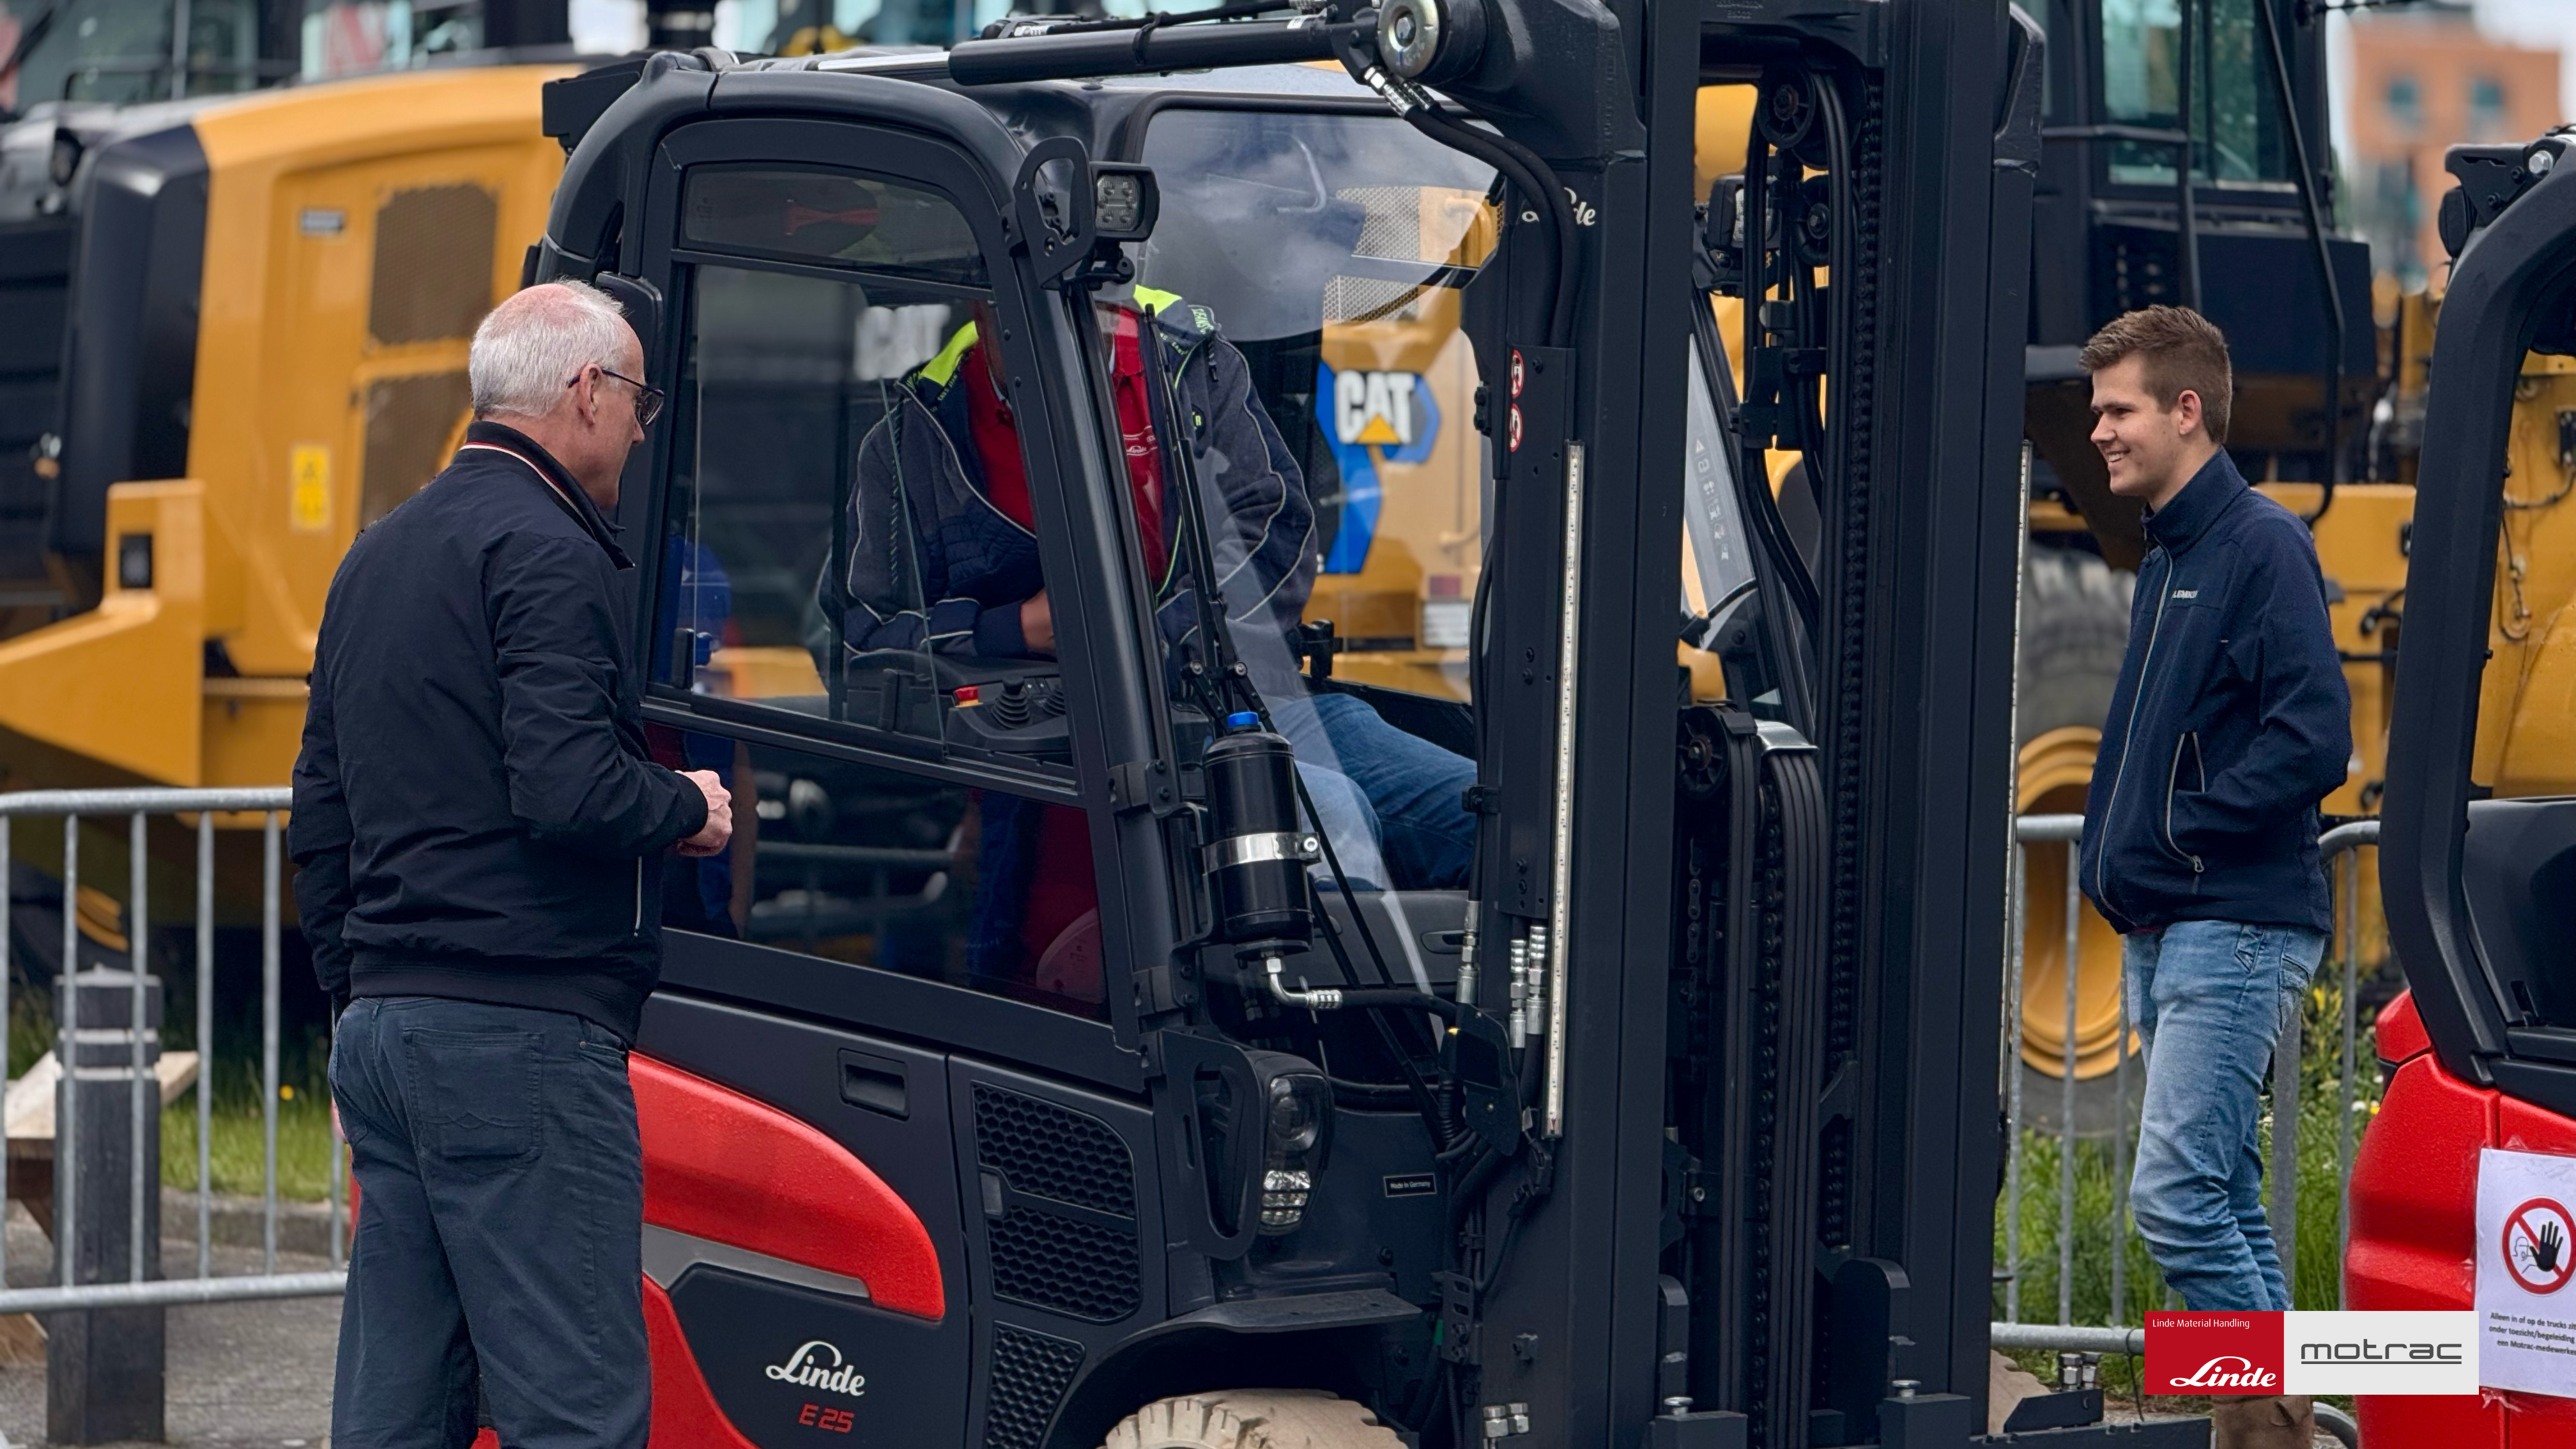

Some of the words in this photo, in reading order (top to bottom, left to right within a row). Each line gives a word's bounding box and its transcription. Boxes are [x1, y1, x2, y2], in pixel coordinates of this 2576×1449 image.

[1334, 369, 1415, 444] CAT
[2488, 1326, 2507, 1334] onder
[2508, 1328, 2575, 1344] toezicht/begeleiding
[2490, 1312, 2510, 1322] Alleen
[2511, 1314, 2517, 1323] in
[2537, 1318, 2545, 1326] de
[2547, 1320, 2567, 1329] trucks
[765, 1340, 866, 1396] Linde
[799, 1404, 819, 1426] E
[818, 1407, 855, 1433] 25
